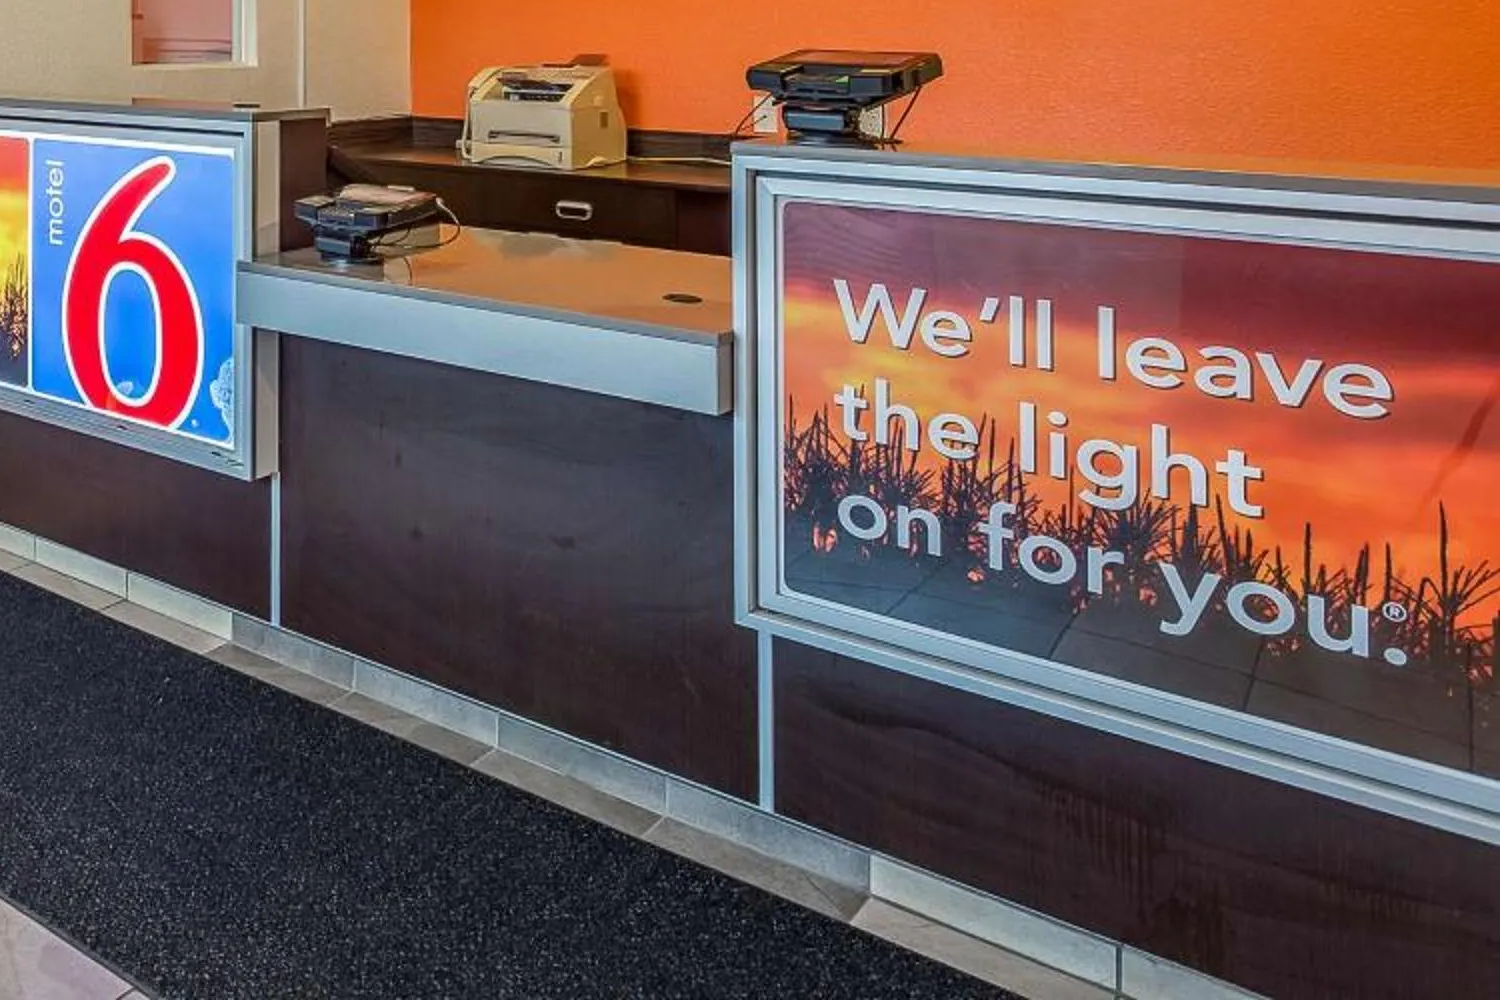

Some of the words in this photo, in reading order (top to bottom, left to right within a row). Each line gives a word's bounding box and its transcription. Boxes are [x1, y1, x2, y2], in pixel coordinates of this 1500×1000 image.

[46, 160, 65, 246] motel
[62, 155, 204, 430] 6
[1097, 306, 1394, 418] leave
[835, 379, 980, 460] the
[1019, 402, 1264, 518] light
[838, 495, 942, 557] on
[980, 503, 1125, 592] for
